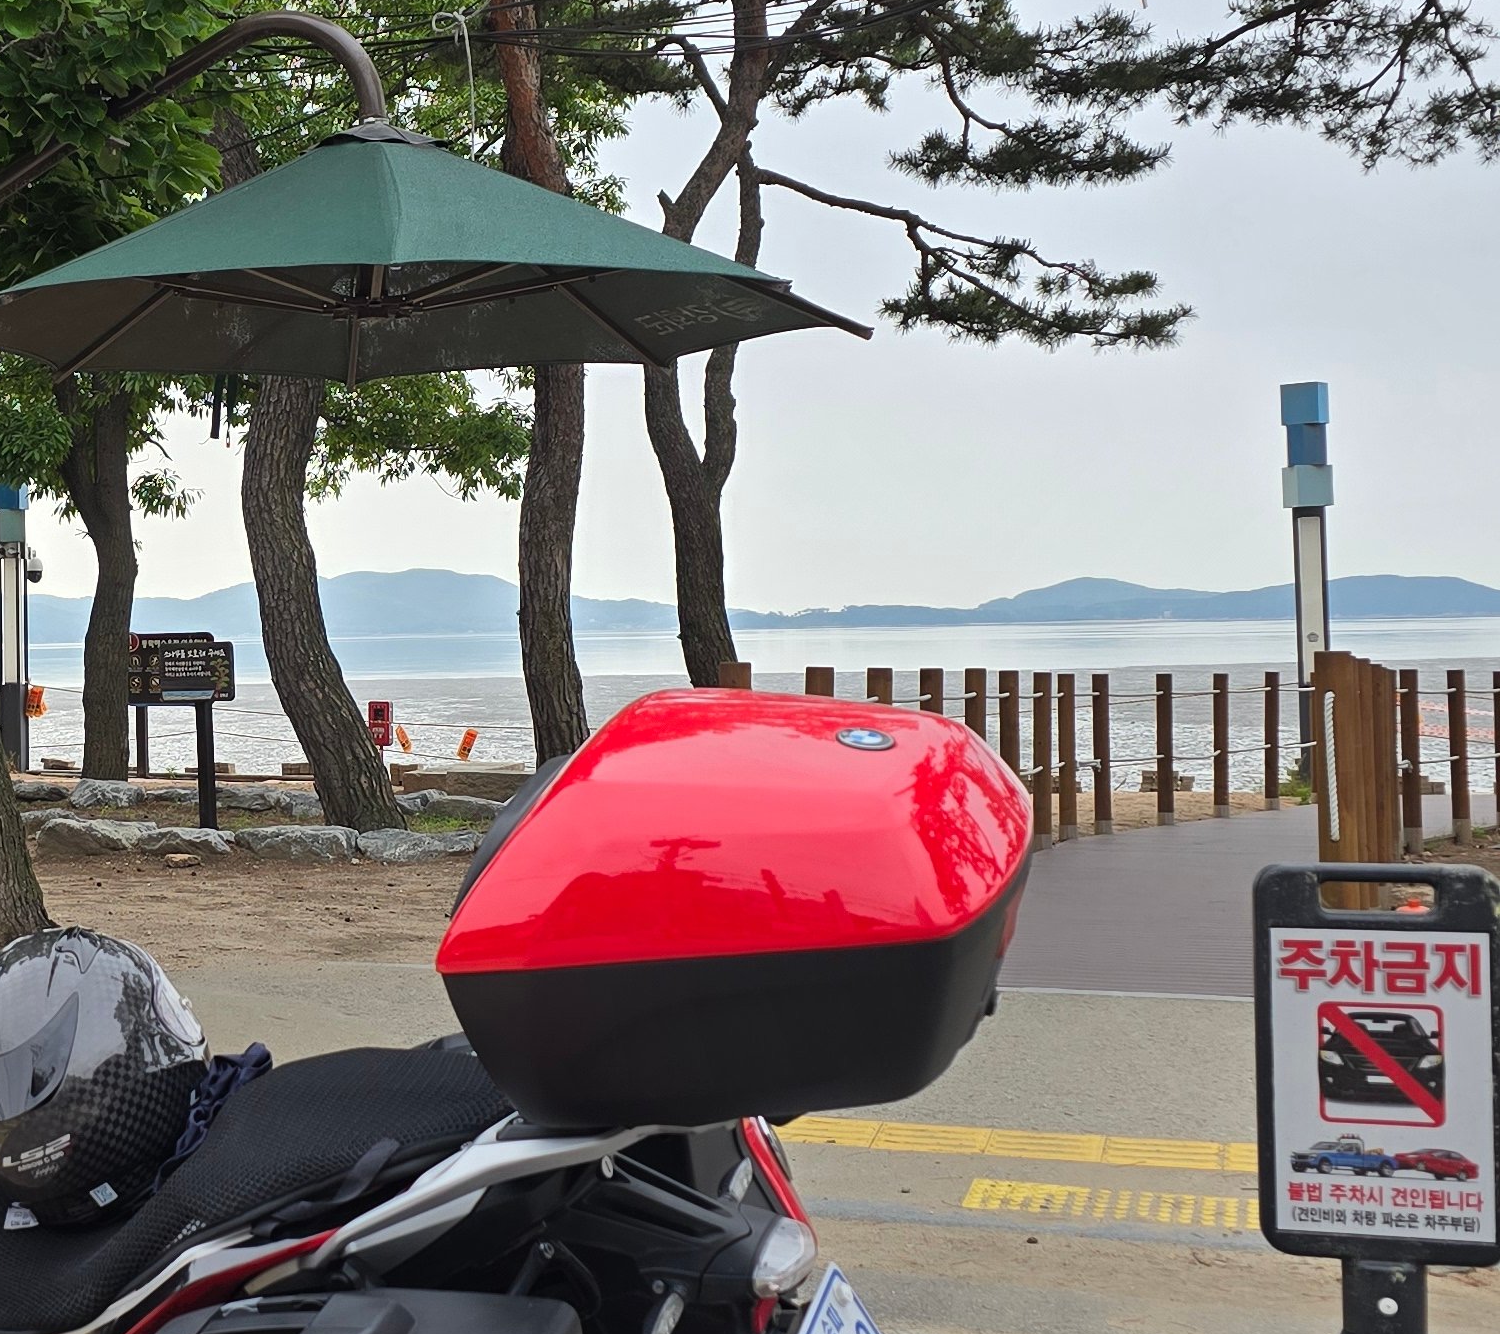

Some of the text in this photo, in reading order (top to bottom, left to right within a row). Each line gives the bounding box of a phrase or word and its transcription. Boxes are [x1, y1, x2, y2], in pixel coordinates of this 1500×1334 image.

[1277, 938, 1484, 998] 주차금지
[2, 1133, 71, 1168] LS2
[1286, 1181, 1484, 1213] 불법 주차시 견인됩니다
[1291, 1205, 1481, 1233] (견인비와 차량 파손은 차주부담)
